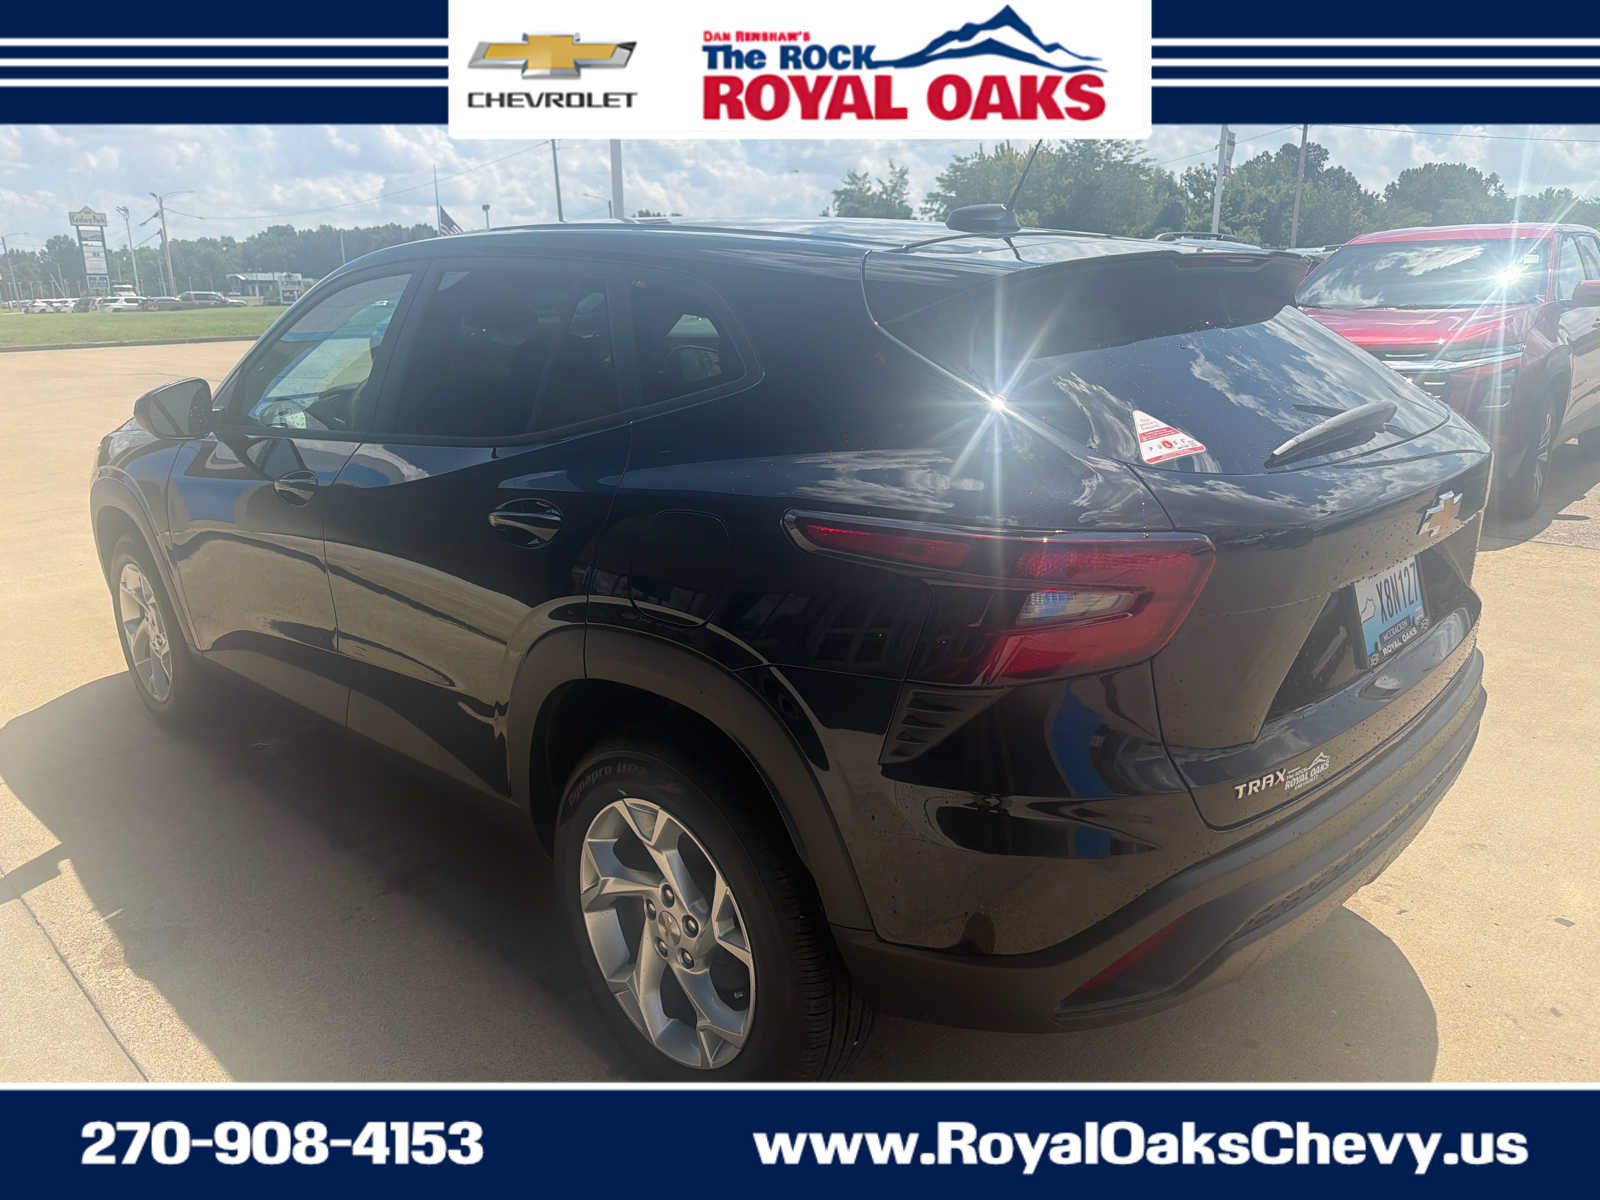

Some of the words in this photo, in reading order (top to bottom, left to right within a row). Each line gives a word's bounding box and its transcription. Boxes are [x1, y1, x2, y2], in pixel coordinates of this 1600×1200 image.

[1375, 563, 1418, 624] X8N127
[1382, 640, 1402, 656] ROYAL
[1234, 769, 1287, 800] TRAX
[1284, 773, 1309, 791] ROYAL
[1310, 762, 1330, 778] OAKS
